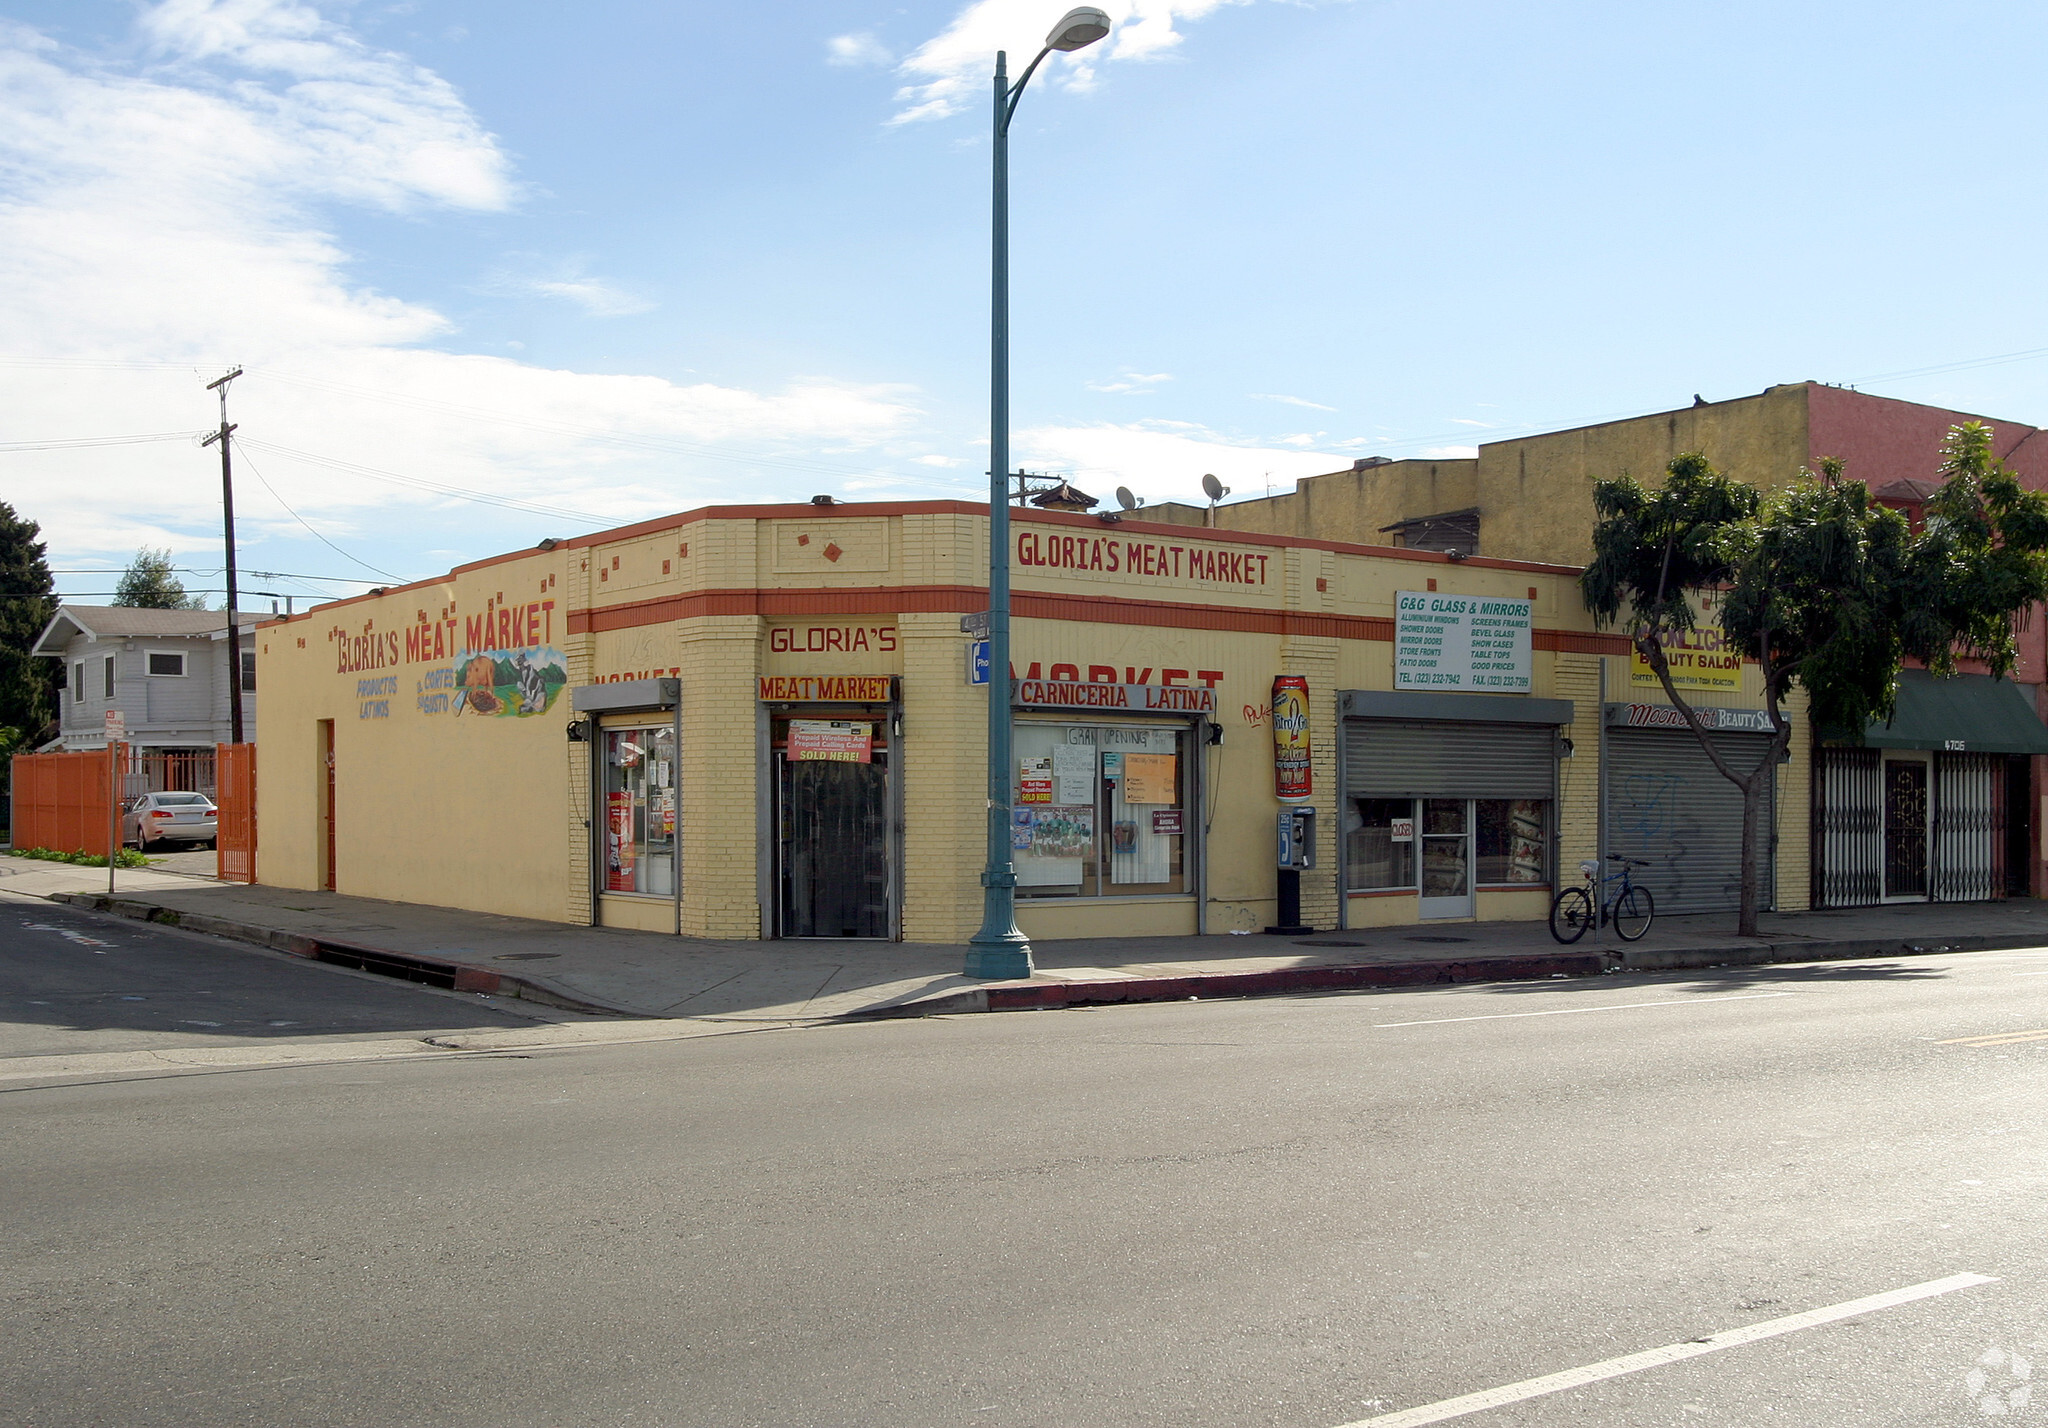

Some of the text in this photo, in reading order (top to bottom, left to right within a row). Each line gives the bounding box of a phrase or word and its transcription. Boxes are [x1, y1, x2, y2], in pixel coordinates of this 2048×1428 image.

[1018, 532, 1268, 585] GLORIA'S MEAT MARKET
[1400, 597, 1529, 616] G&G GLASS & MIRRORS
[1434, 616, 1460, 625] WINDOWS
[1471, 618, 1528, 628] SCREENS FRAMES
[1400, 625, 1443, 634] SHOWER DOORS
[1471, 629, 1515, 638] BEVEL GLASS
[337, 600, 554, 674] GLORIA'S MEAT MARKET
[770, 627, 897, 653] GLORIA'S
[1400, 636, 1442, 645] MIRROR DOORS
[1471, 640, 1514, 649] SHOW CASES
[1400, 647, 1441, 656] STORE FRONTS
[1471, 651, 1510, 659] TABLE TOPS
[977, 658, 990, 668] Pho
[1400, 659, 1417, 667] PATIO
[1640, 652, 1740, 670] BUTY SALON
[1471, 662, 1515, 671] GOOD PRICES
[759, 676, 888, 701] MEAT MARKET
[1021, 681, 1213, 711] CARNICERIA LATINA
[1718, 709, 1756, 728] BEAUTY
[1944, 740, 1965, 750] 4706
[800, 750, 859, 761] SOLD HERE!
